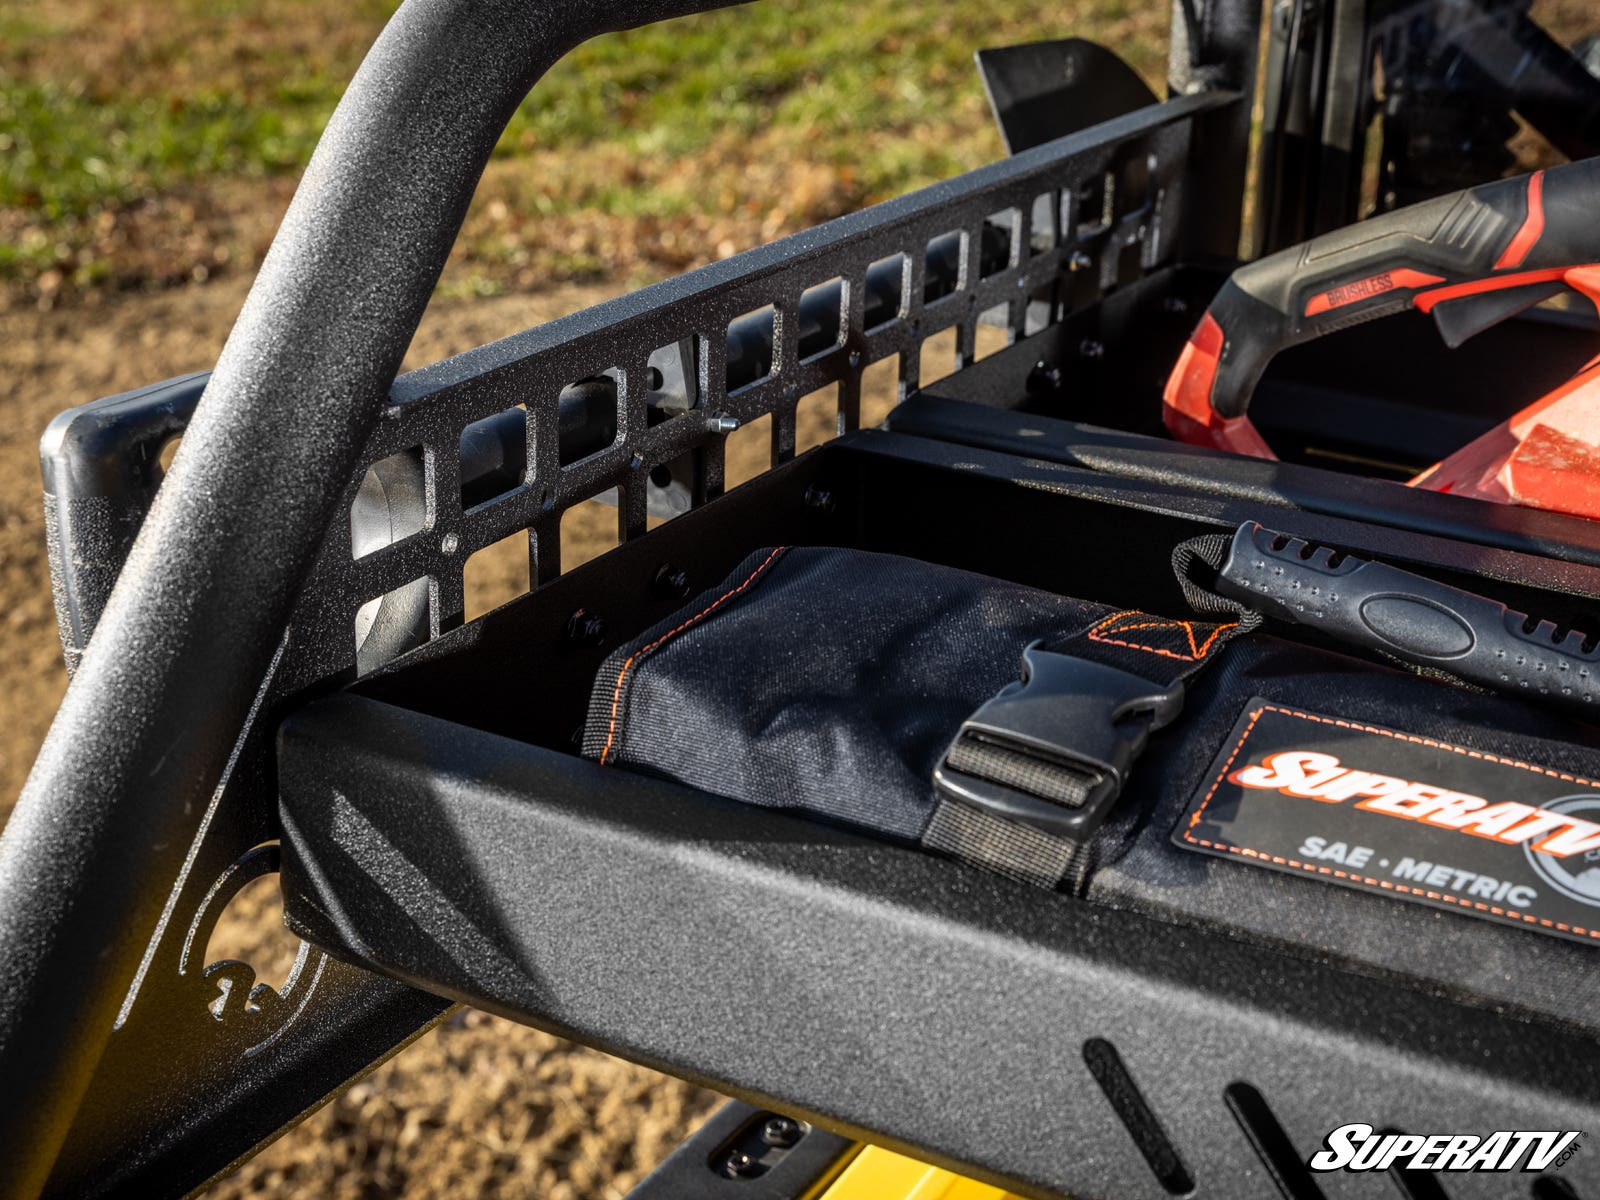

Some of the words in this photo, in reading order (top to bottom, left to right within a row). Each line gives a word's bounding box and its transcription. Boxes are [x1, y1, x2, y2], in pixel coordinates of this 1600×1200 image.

[1327, 274, 1393, 306] BRUSHLESS
[1299, 836, 1374, 868] SAE
[1392, 857, 1538, 908] METRIC
